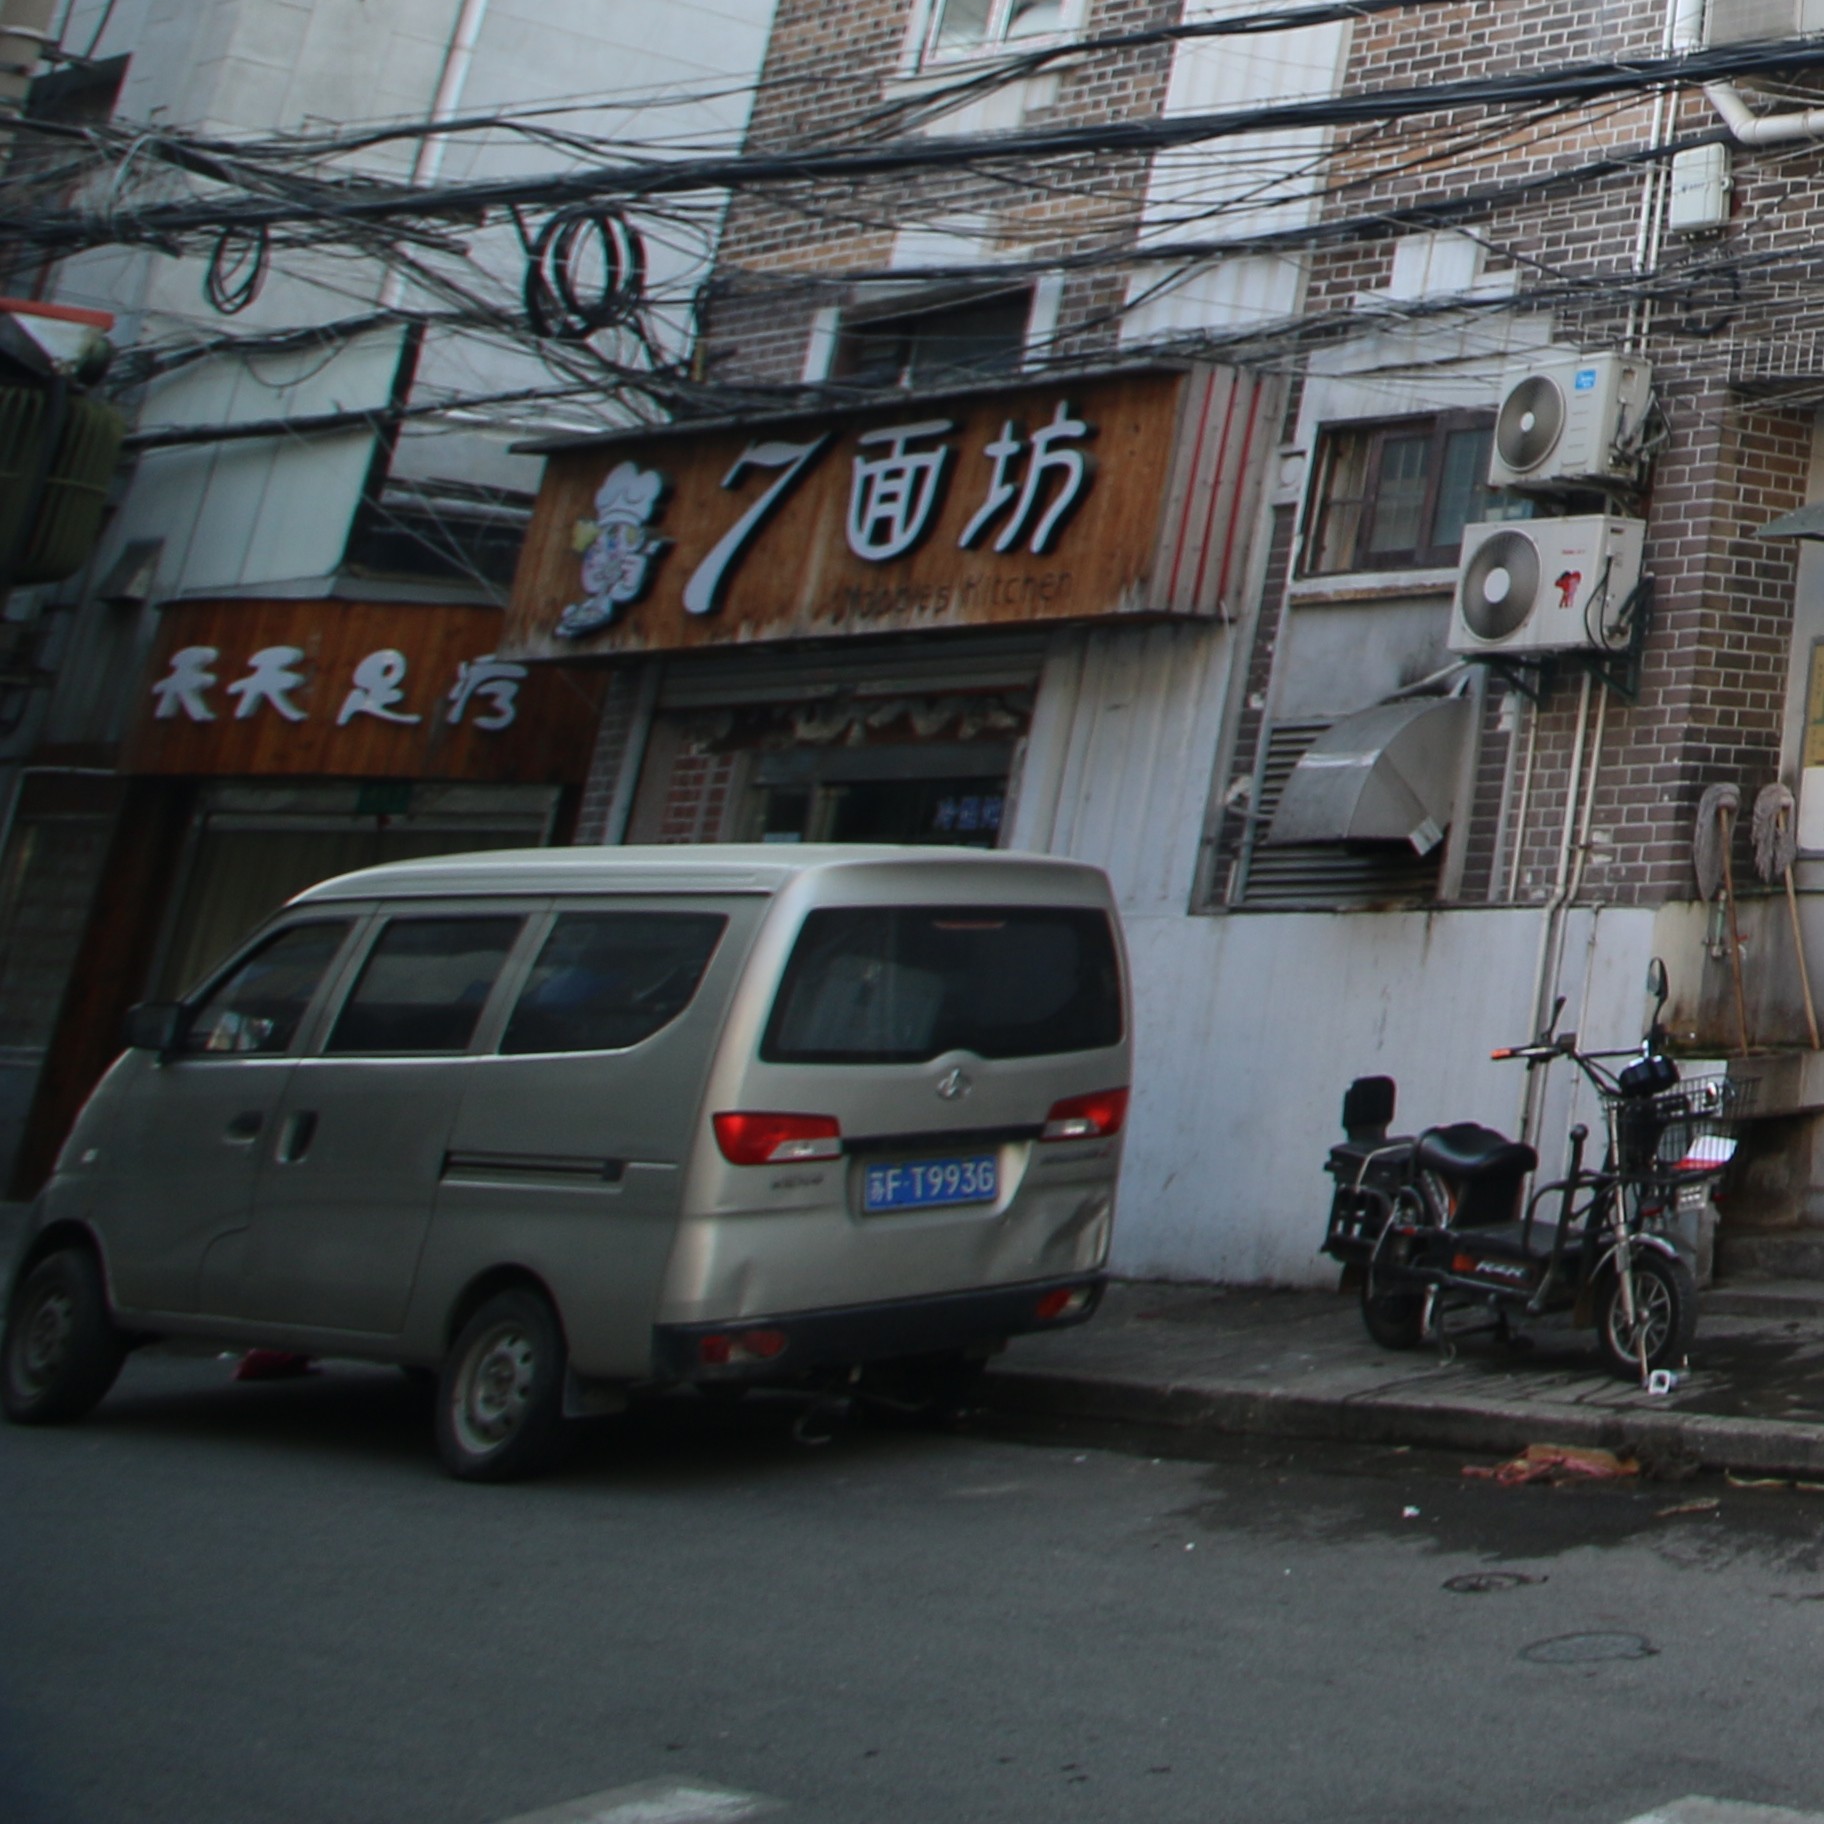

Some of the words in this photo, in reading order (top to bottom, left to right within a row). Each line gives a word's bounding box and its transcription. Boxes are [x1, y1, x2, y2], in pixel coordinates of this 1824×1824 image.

[683, 399, 1090, 614] 7面坊
[152, 645, 528, 730] 天天足疗
